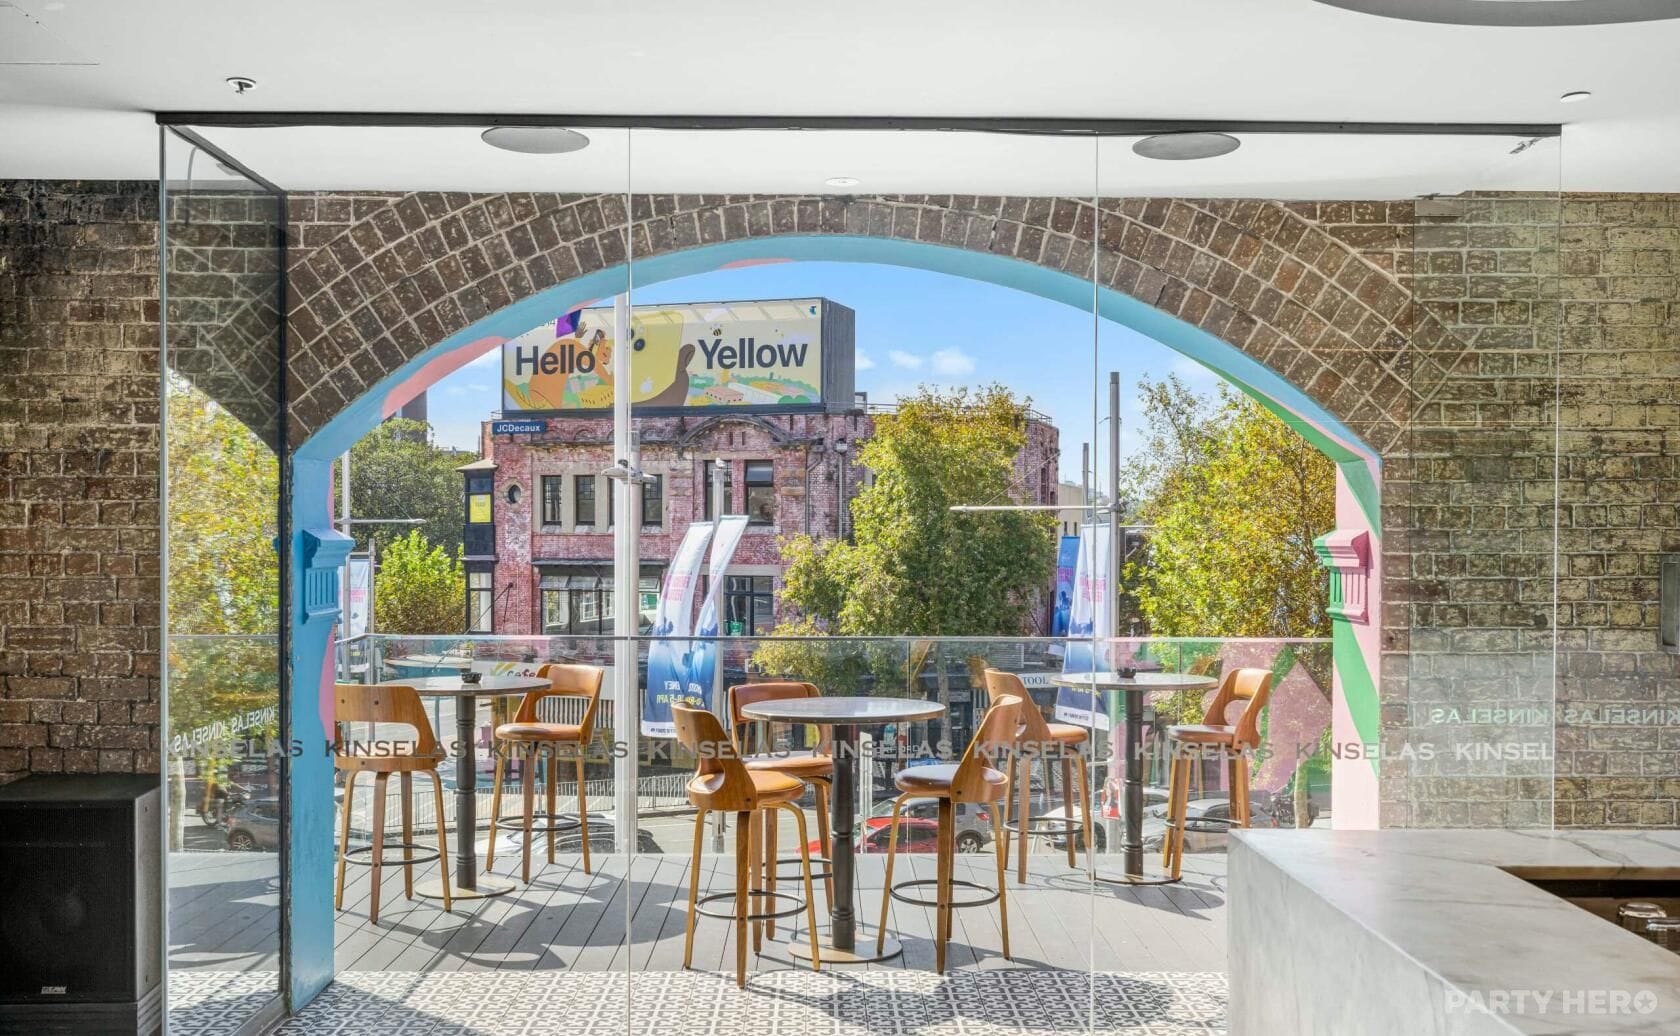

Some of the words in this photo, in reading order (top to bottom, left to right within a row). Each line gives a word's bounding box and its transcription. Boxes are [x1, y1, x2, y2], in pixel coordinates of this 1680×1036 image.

[515, 344, 596, 376] Hello
[698, 337, 808, 370] Yellow
[496, 424, 541, 433] JCDecaux
[325, 740, 468, 758] KINSELAS
[645, 740, 791, 760] KINSELAS
[973, 740, 1114, 760] KINSELAS
[1134, 742, 1274, 760] KINSELAS
[1296, 742, 1435, 760] KINSELAS
[1455, 742, 1554, 760] KINSEL
